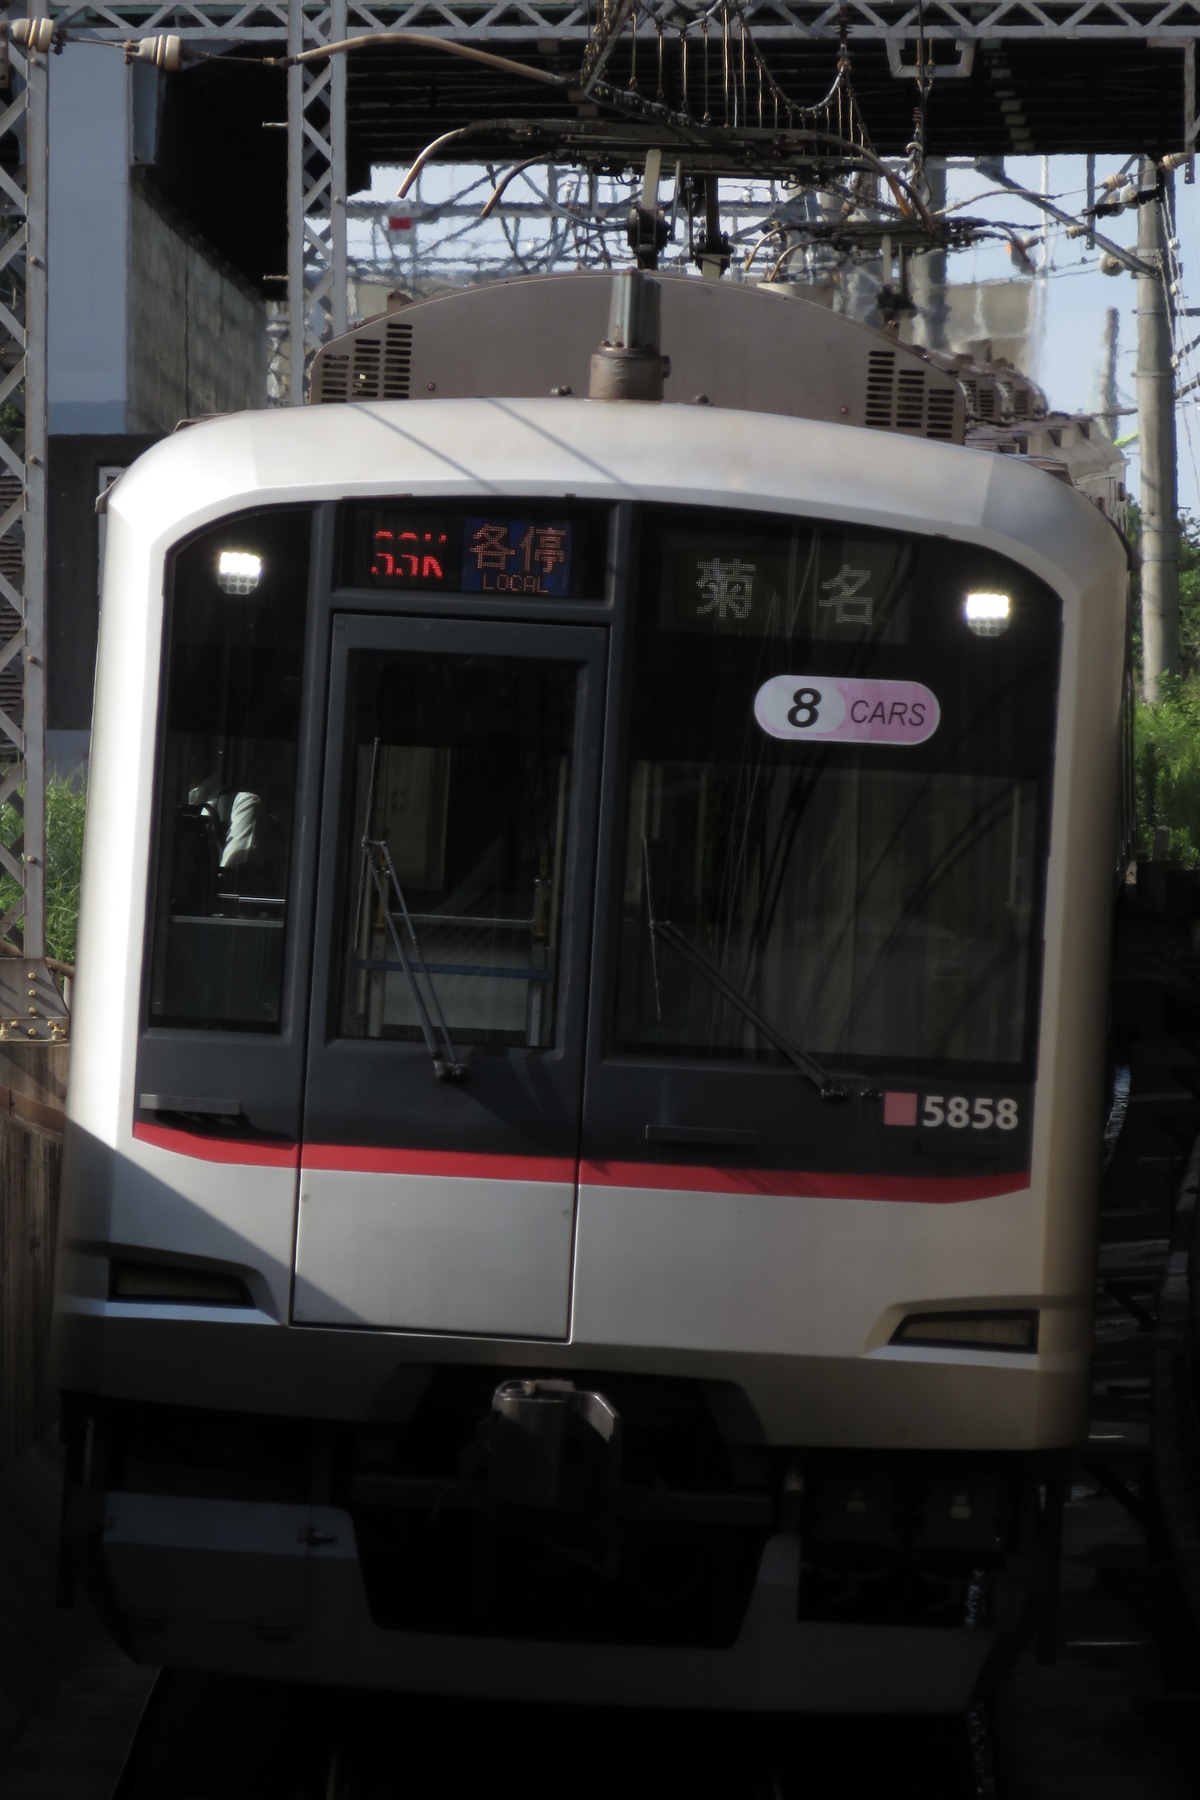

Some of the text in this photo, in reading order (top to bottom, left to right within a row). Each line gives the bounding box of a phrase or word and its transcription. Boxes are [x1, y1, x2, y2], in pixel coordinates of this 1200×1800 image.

[469, 523, 567, 573] 各停
[482, 573, 549, 593] LOCAL
[696, 557, 873, 625] 菊名
[787, 688, 927, 728] 8 CARS
[922, 1096, 1019, 1130] 5858
